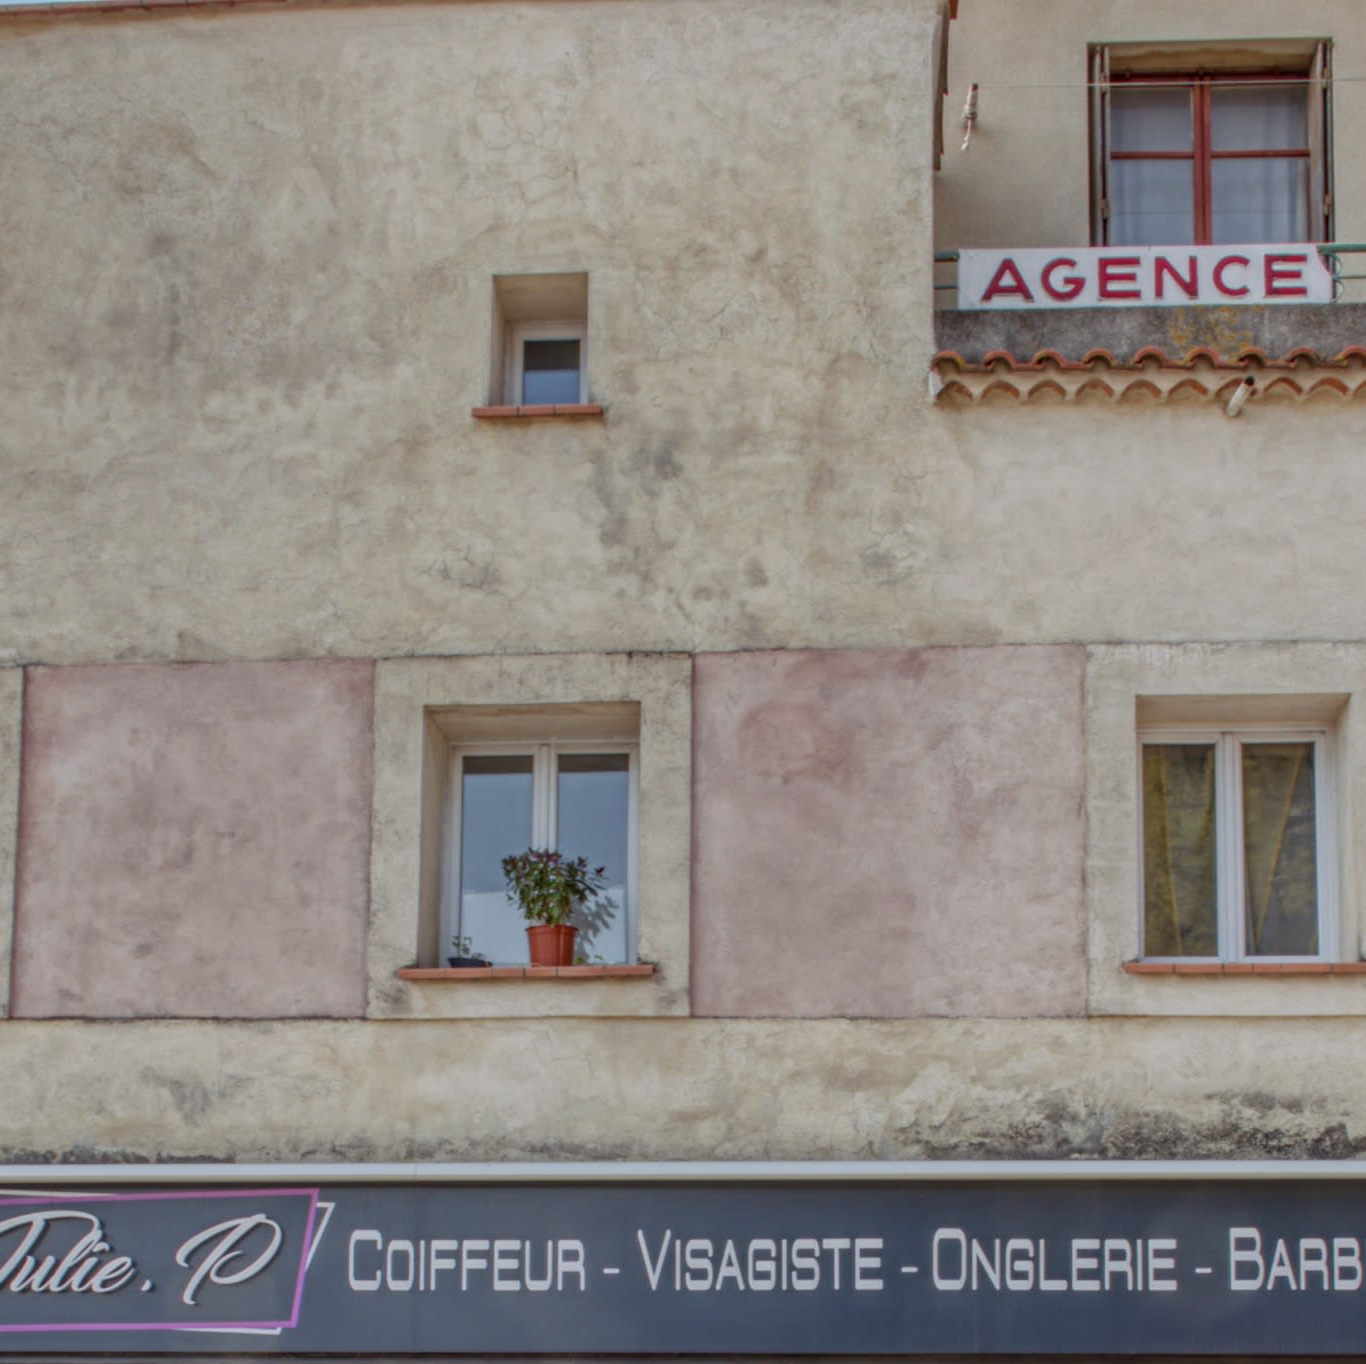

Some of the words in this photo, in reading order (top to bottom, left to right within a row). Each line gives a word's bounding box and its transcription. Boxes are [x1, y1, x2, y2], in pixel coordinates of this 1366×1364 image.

[980, 254, 1308, 302] AGENCE
[175, 1213, 283, 1306] P
[347, 1229, 586, 1291] COIFFEUR
[637, 1228, 884, 1291] VISAGISTE
[933, 1227, 1178, 1291] ONGLERIE
